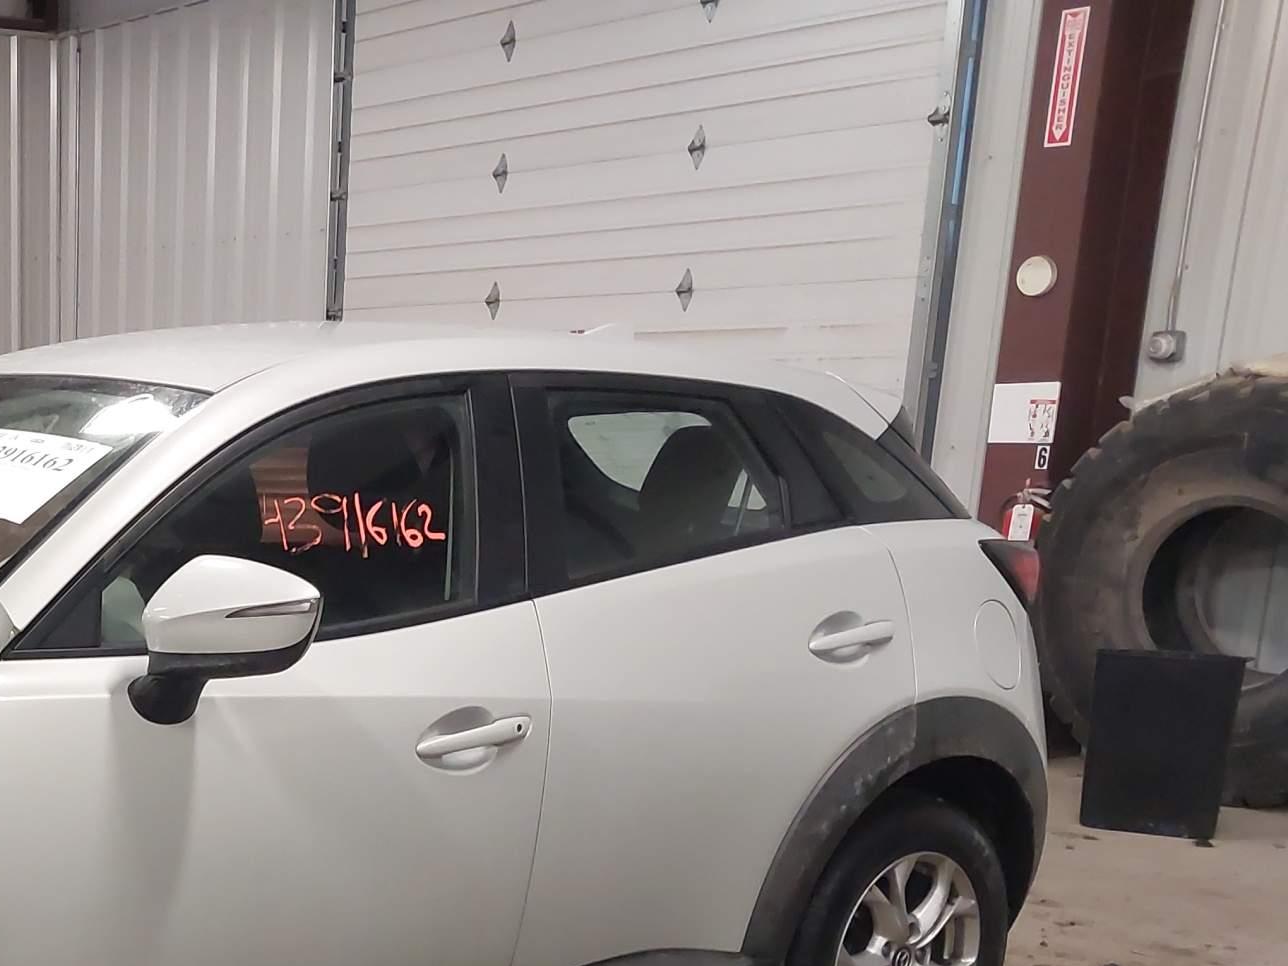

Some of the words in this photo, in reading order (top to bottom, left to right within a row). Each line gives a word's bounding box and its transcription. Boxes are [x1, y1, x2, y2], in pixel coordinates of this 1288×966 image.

[1054, 33, 1076, 130] EXTINGUISHER
[1037, 447, 1048, 469] 6
[263, 492, 446, 558] 43916162
